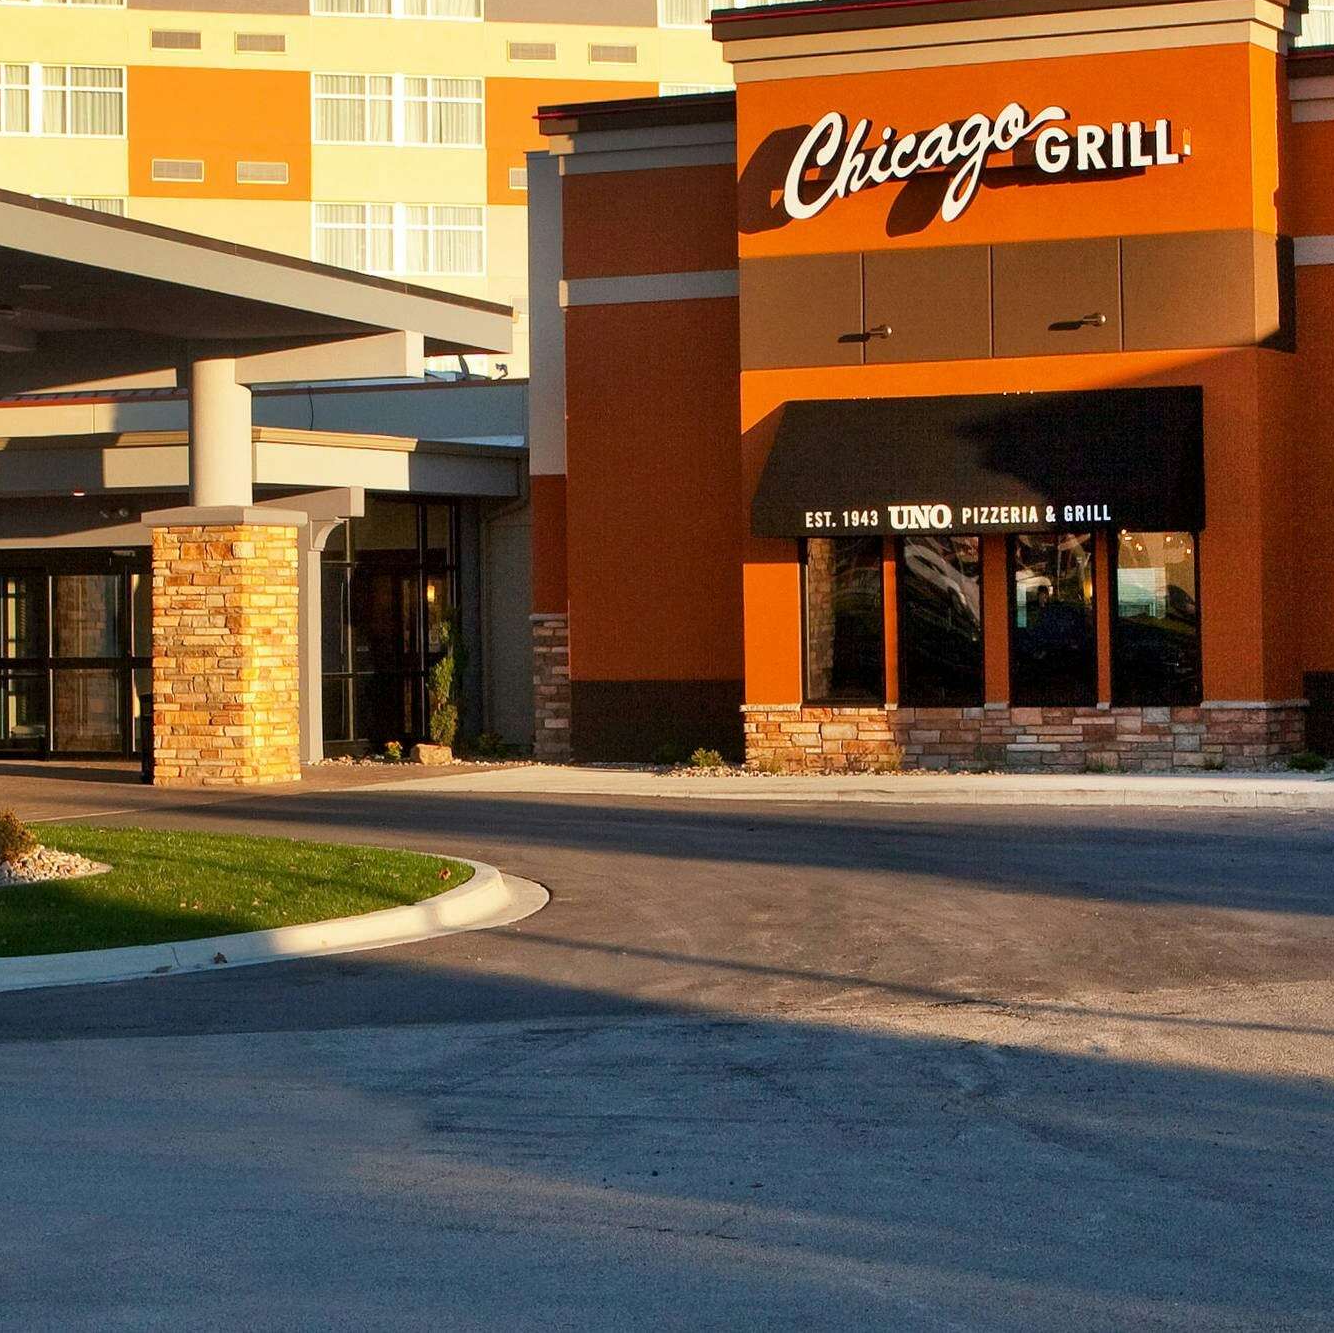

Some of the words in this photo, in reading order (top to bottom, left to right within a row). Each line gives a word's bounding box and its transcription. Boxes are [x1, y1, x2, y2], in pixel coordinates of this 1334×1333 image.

[783, 102, 1066, 222] Chicago
[805, 511, 837, 529] EST.
[842, 509, 879, 527] 1943
[962, 505, 1039, 525] PIZZERIA
[1045, 505, 1056, 522] &
[1064, 504, 1111, 522] GRILL
